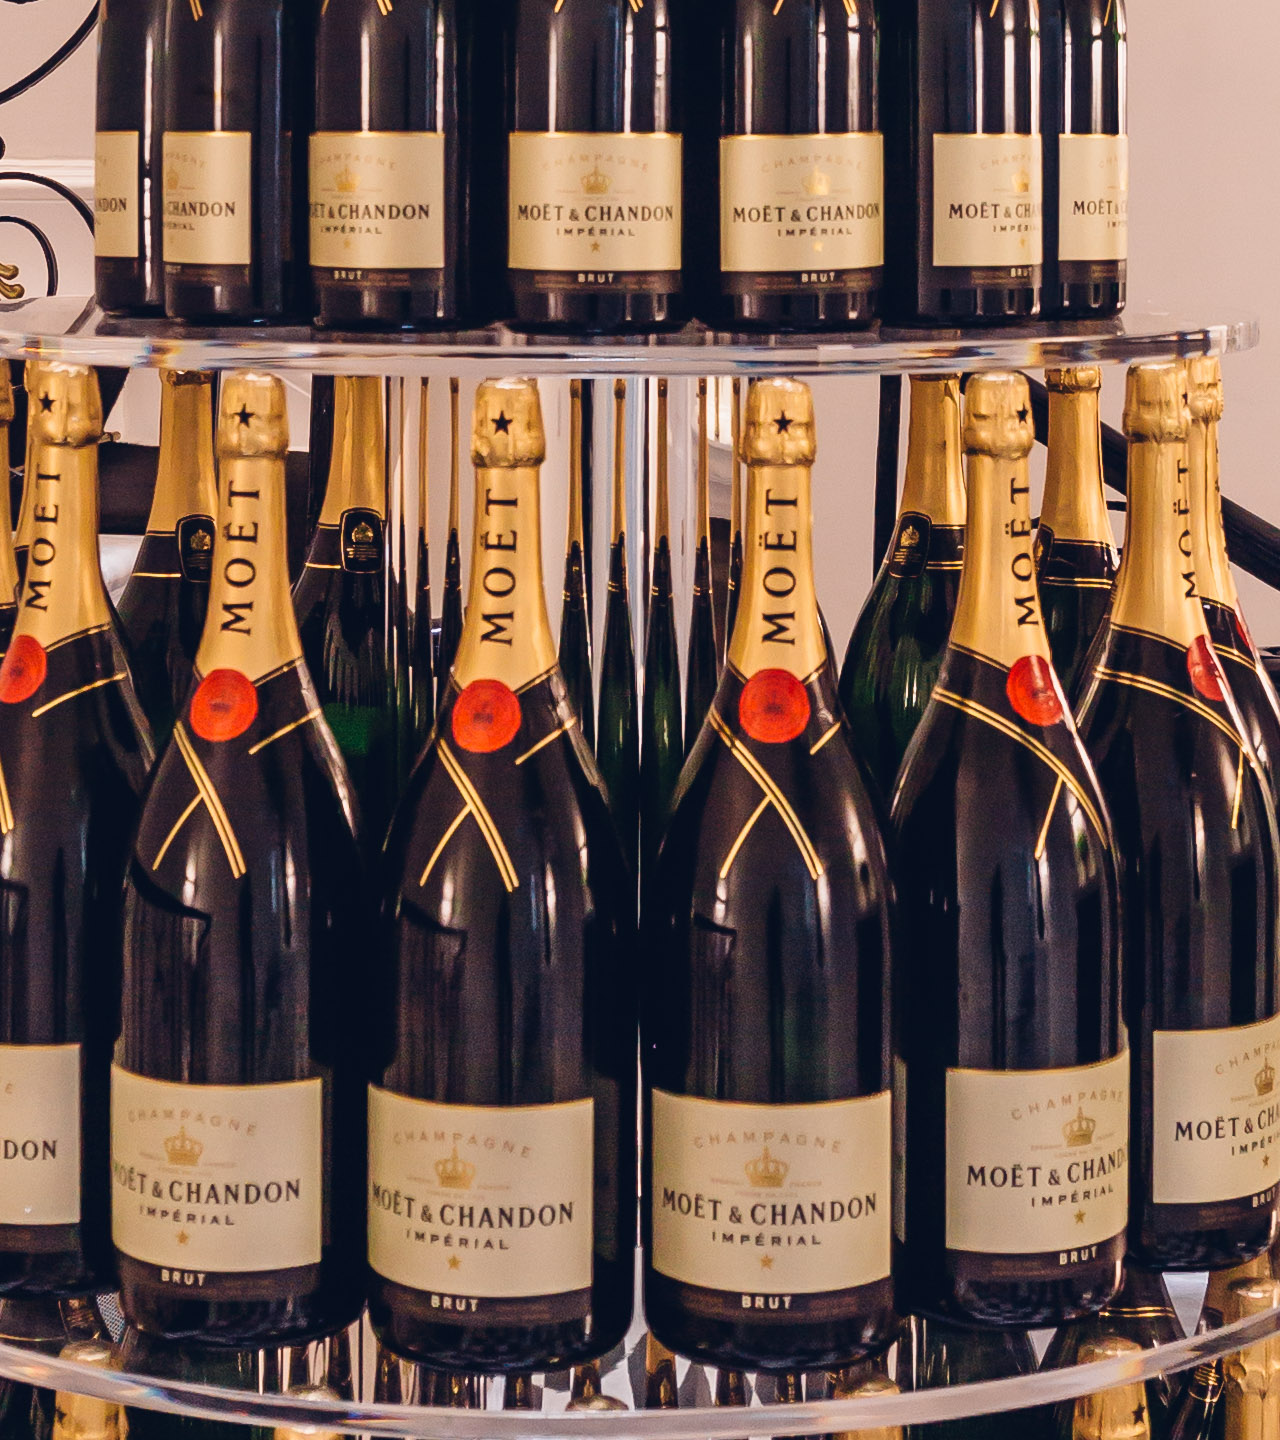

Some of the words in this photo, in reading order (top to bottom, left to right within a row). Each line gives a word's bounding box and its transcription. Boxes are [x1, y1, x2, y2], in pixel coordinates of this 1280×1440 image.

[338, 204, 430, 220] CHANDON
[518, 204, 563, 221] MOËT
[569, 208, 579, 221] &
[584, 205, 673, 221] CHANDON
[733, 206, 786, 223] MOËT
[791, 209, 801, 222] &
[807, 203, 880, 221] CHANDON
[948, 202, 1000, 219] MOËT
[1004, 207, 1011, 218] &
[557, 225, 636, 237] IMPÉRIAL
[778, 225, 852, 237] IMPÉRIAL
[578, 273, 614, 283] BRUT
[802, 272, 836, 283] BRUT
[759, 488, 797, 646] MOËT
[1175, 1116, 1240, 1141] MOËT
[1244, 1118, 1253, 1134] &
[393, 1131, 531, 1158] CHAMPAGNE
[694, 1131, 842, 1154] CHAMPAGNE
[968, 1162, 1041, 1188] MOËT
[1048, 1169, 1061, 1185] &
[152, 1182, 162, 1198] &
[170, 1179, 300, 1205] CHANDON
[1031, 1184, 1114, 1207] IMPÉRIAL
[139, 1205, 235, 1226] IMPÉRIAL
[421, 1205, 432, 1223] &
[440, 1202, 574, 1229] CHANDON
[662, 1188, 721, 1221] MOËT
[729, 1206, 742, 1224] &
[751, 1193, 877, 1225] CHANDON
[405, 1229, 509, 1250] IMPÉRIAL
[712, 1232, 821, 1247] IMPÉRIAL
[1059, 1246, 1098, 1265] BRUT
[161, 1269, 206, 1287] BRUT
[431, 1295, 479, 1312] BRUT
[741, 1295, 792, 1309] BRUT
